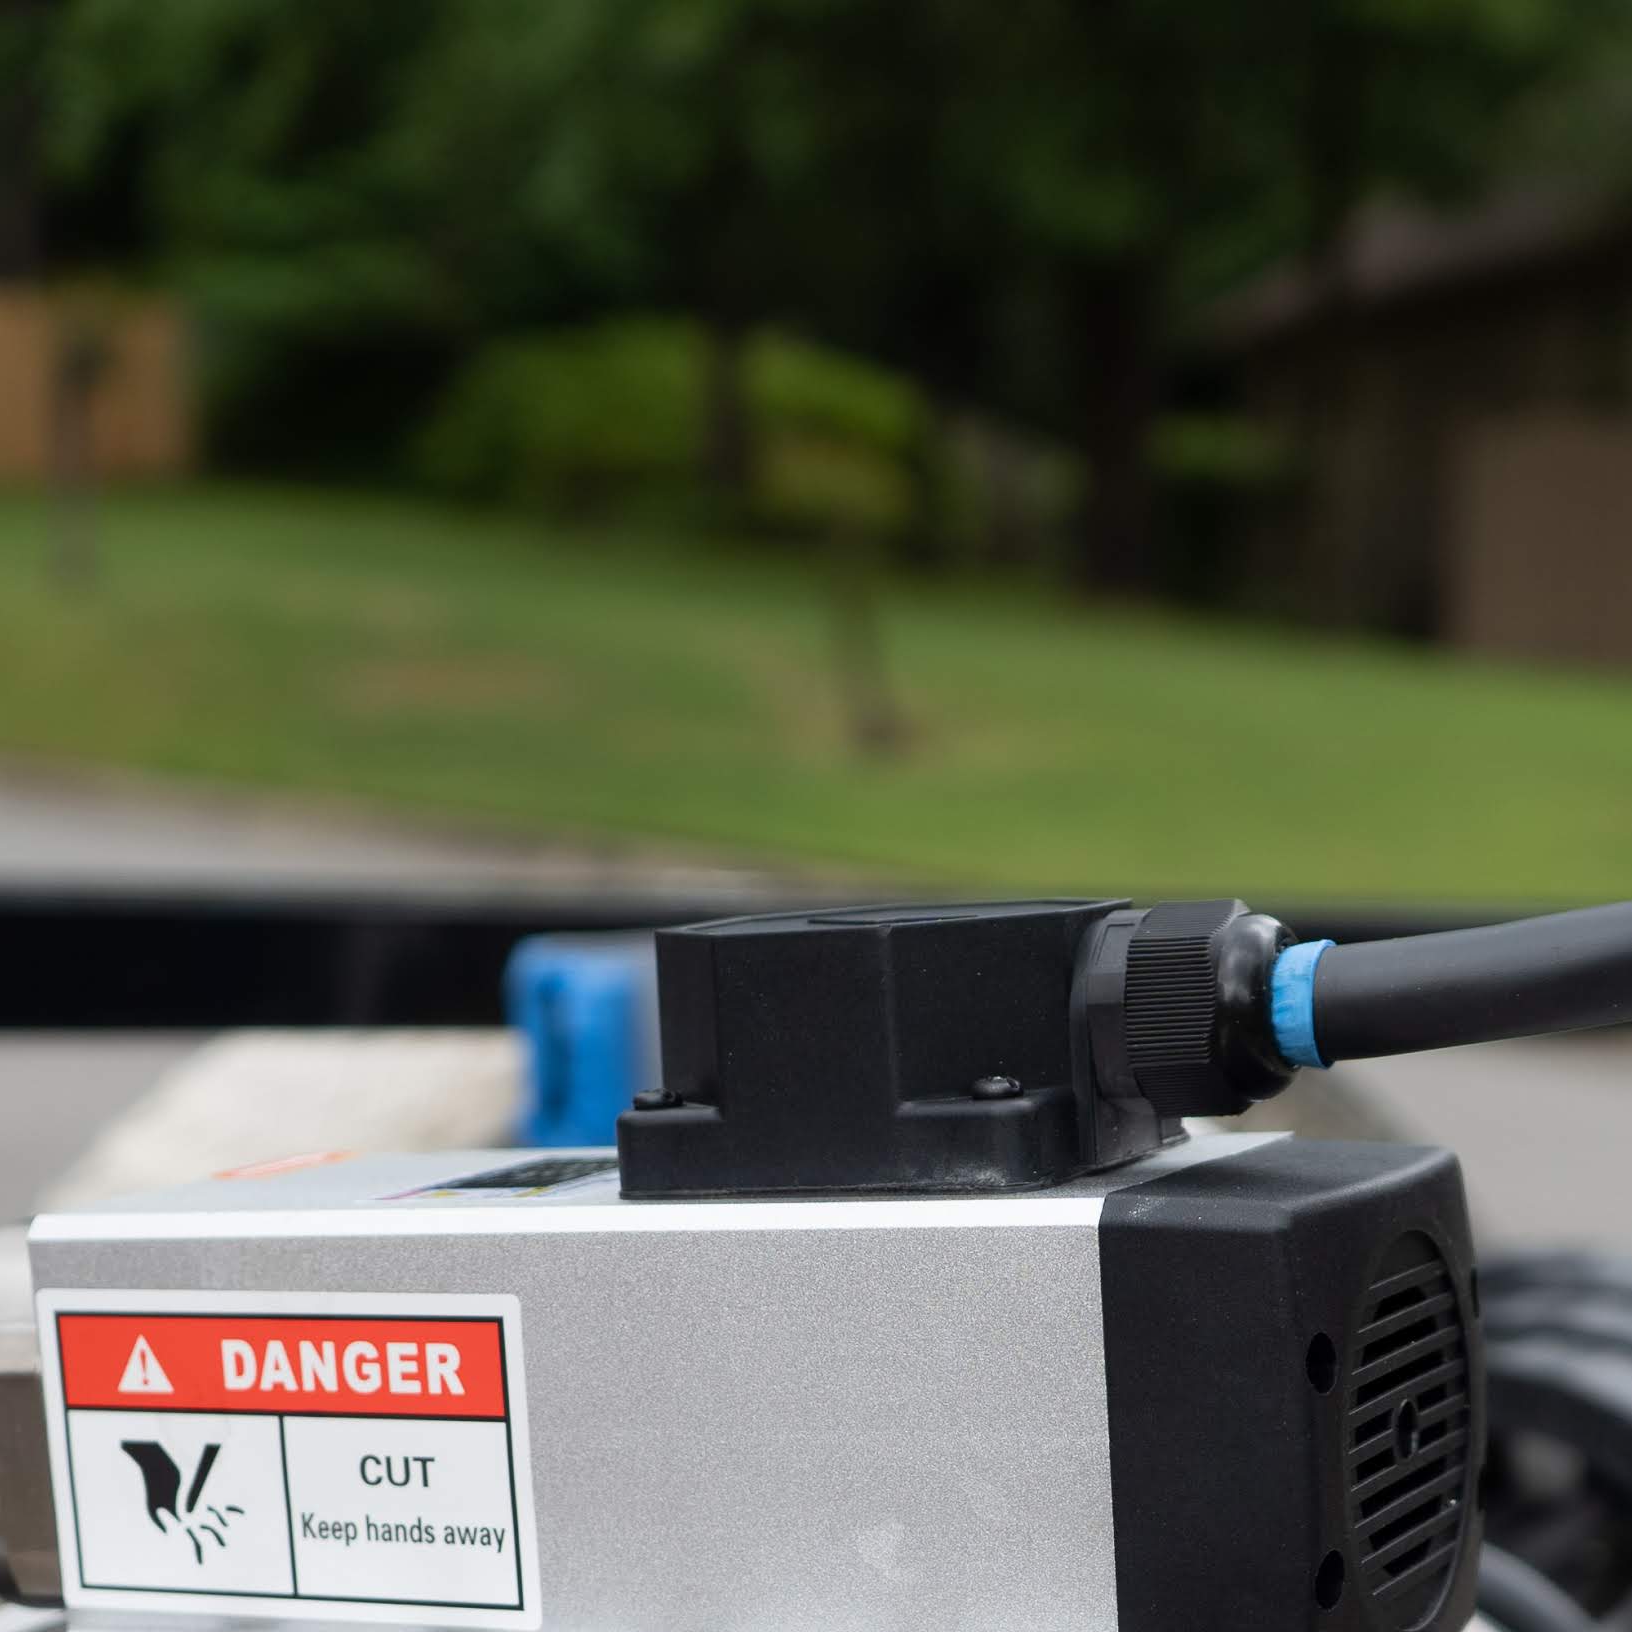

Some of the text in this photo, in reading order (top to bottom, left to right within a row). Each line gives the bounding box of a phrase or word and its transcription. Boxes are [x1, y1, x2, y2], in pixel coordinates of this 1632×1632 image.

[221, 1339, 465, 1395] DANGER
[360, 1455, 435, 1487] CUT
[301, 1512, 506, 1552] Keep hands away
